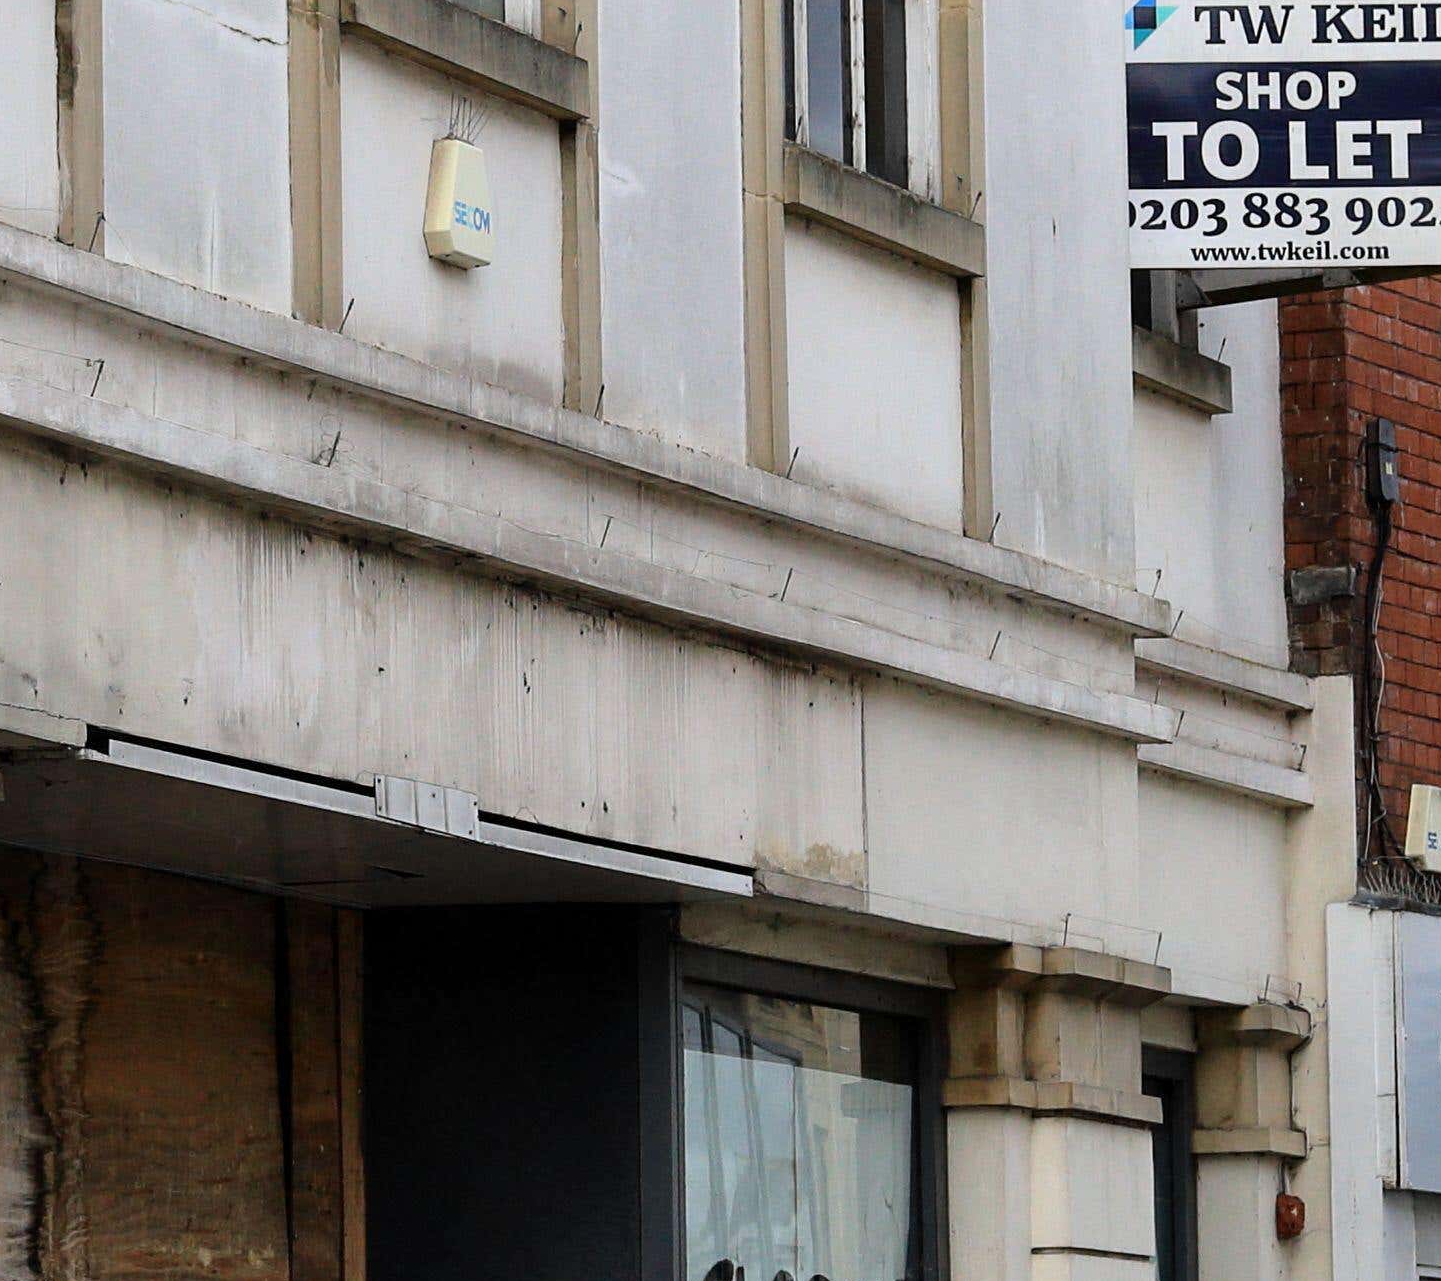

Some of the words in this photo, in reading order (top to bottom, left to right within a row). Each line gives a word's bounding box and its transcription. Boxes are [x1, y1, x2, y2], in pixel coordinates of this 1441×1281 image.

[1194, 4, 1294, 45] TW
[1215, 70, 1357, 111] SHOP
[1152, 119, 1260, 182] TO
[1288, 119, 1422, 180] LET
[1129, 197, 1228, 237] 203
[1242, 192, 1331, 236] 883
[1191, 241, 1390, 262] www.twkeil.com
